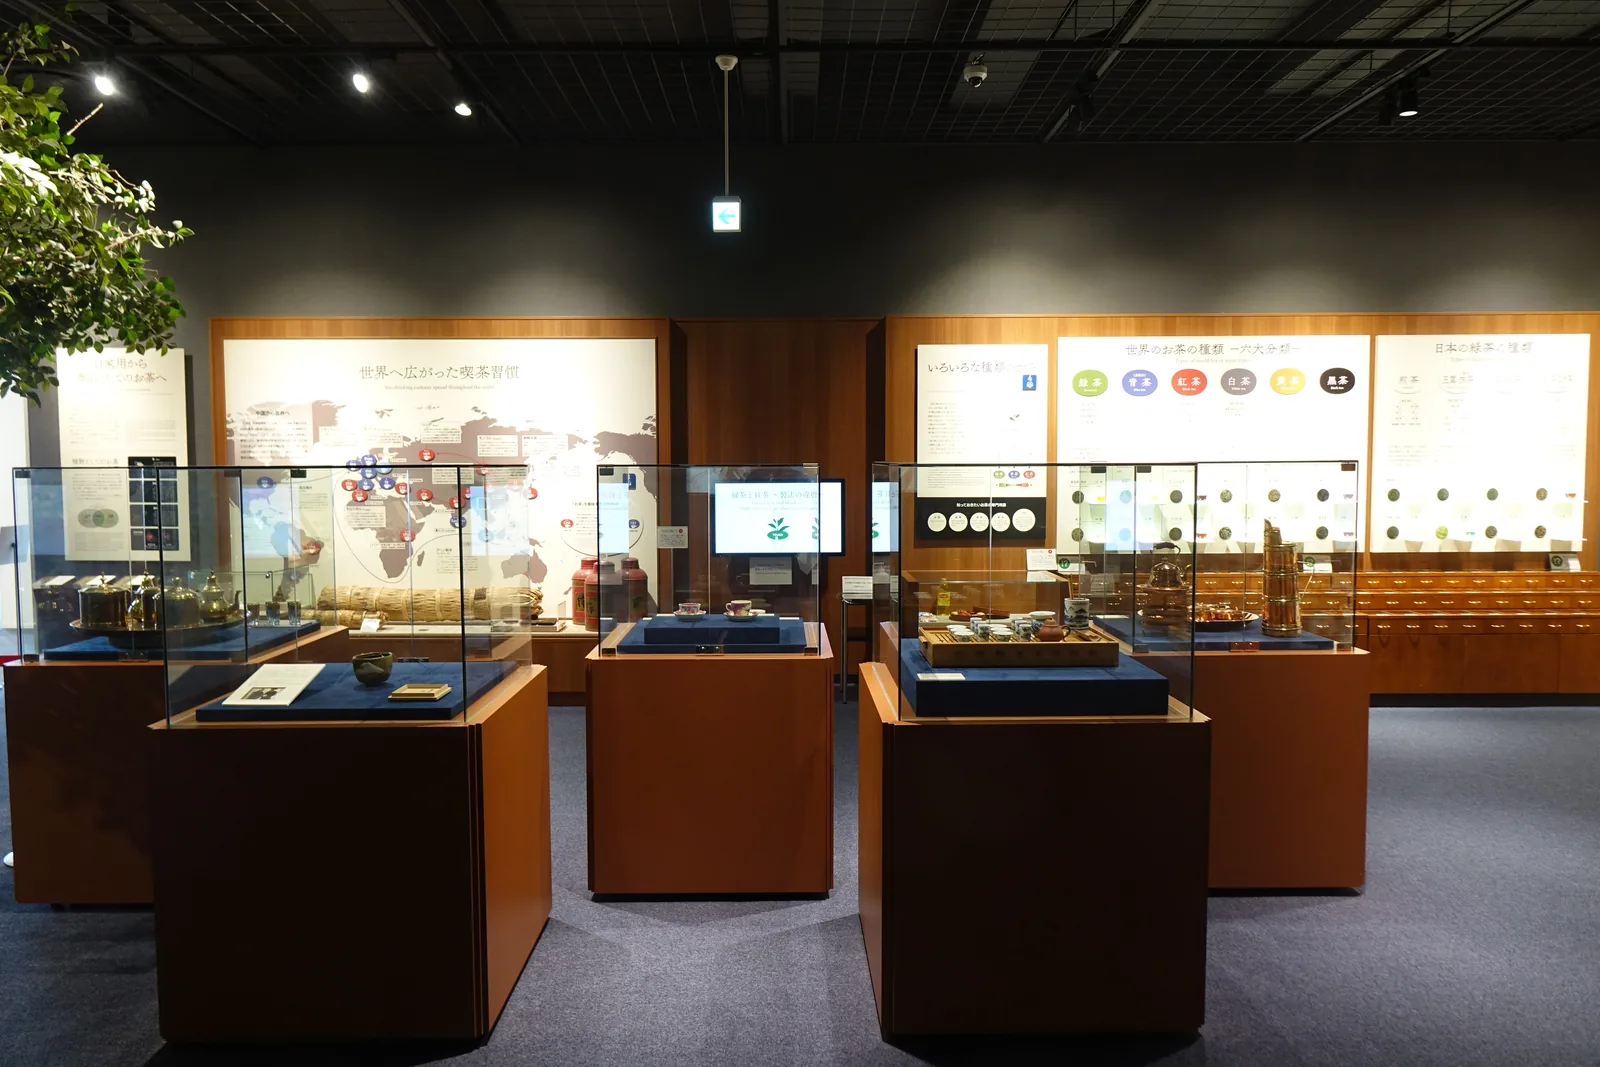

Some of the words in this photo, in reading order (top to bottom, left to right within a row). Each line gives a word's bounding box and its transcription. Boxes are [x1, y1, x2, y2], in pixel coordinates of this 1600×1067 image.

[1125, 343, 1225, 356] 世界のお茶の種類
[358, 364, 520, 380] 世界へ広がった喫茶習慣
[1078, 377, 1102, 388] 緑茶
[1128, 377, 1152, 387] 青茶
[1177, 377, 1201, 387] 紅茶
[1228, 376, 1251, 386] 白茶
[1327, 375, 1349, 386] 黒茶
